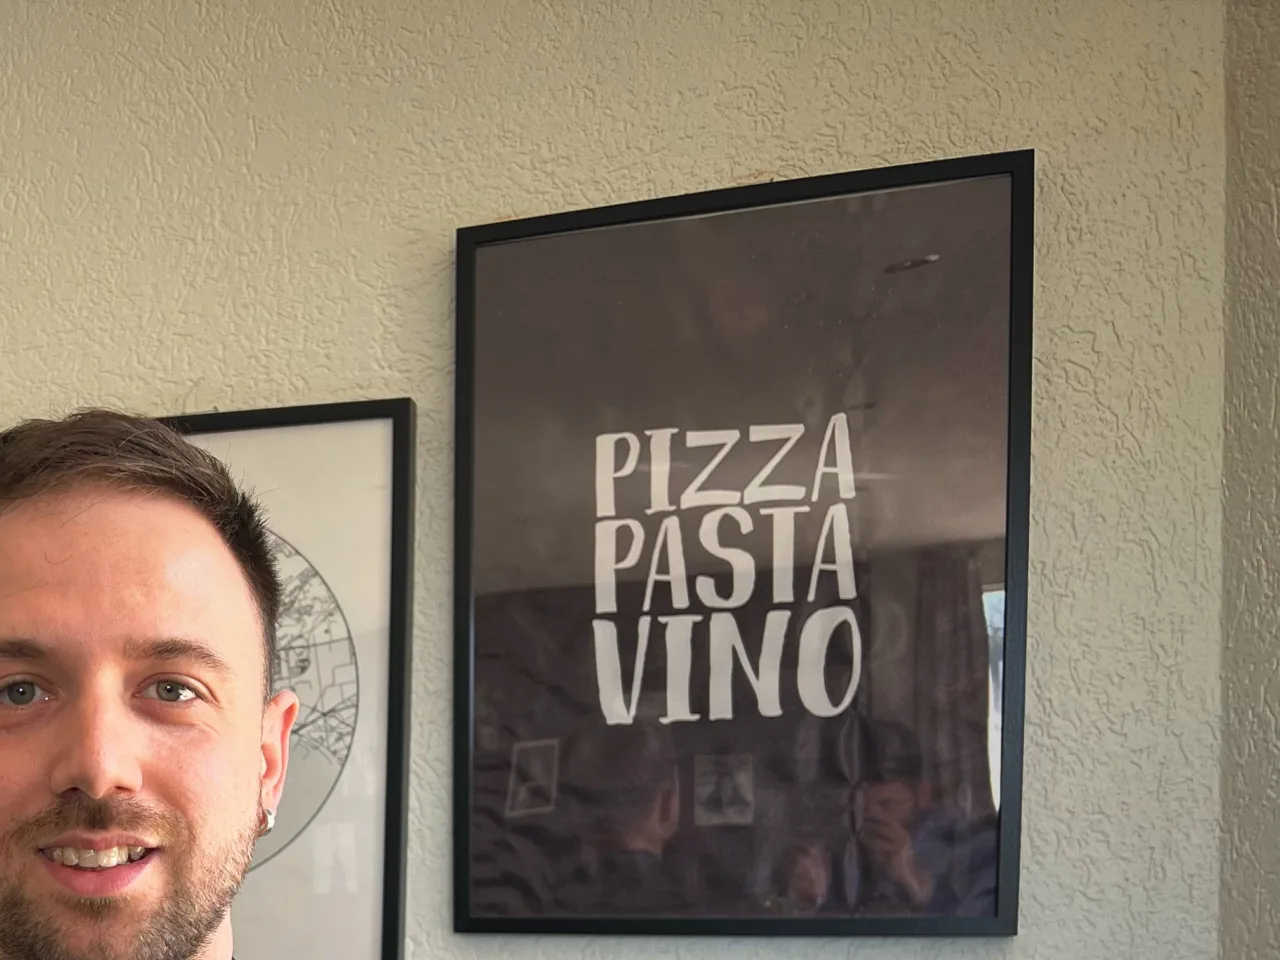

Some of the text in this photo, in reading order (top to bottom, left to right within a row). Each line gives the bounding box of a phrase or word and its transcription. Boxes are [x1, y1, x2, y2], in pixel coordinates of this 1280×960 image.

[596, 412, 856, 517] PIZZA
[594, 502, 858, 614] PASTA
[592, 606, 862, 725] VINO
